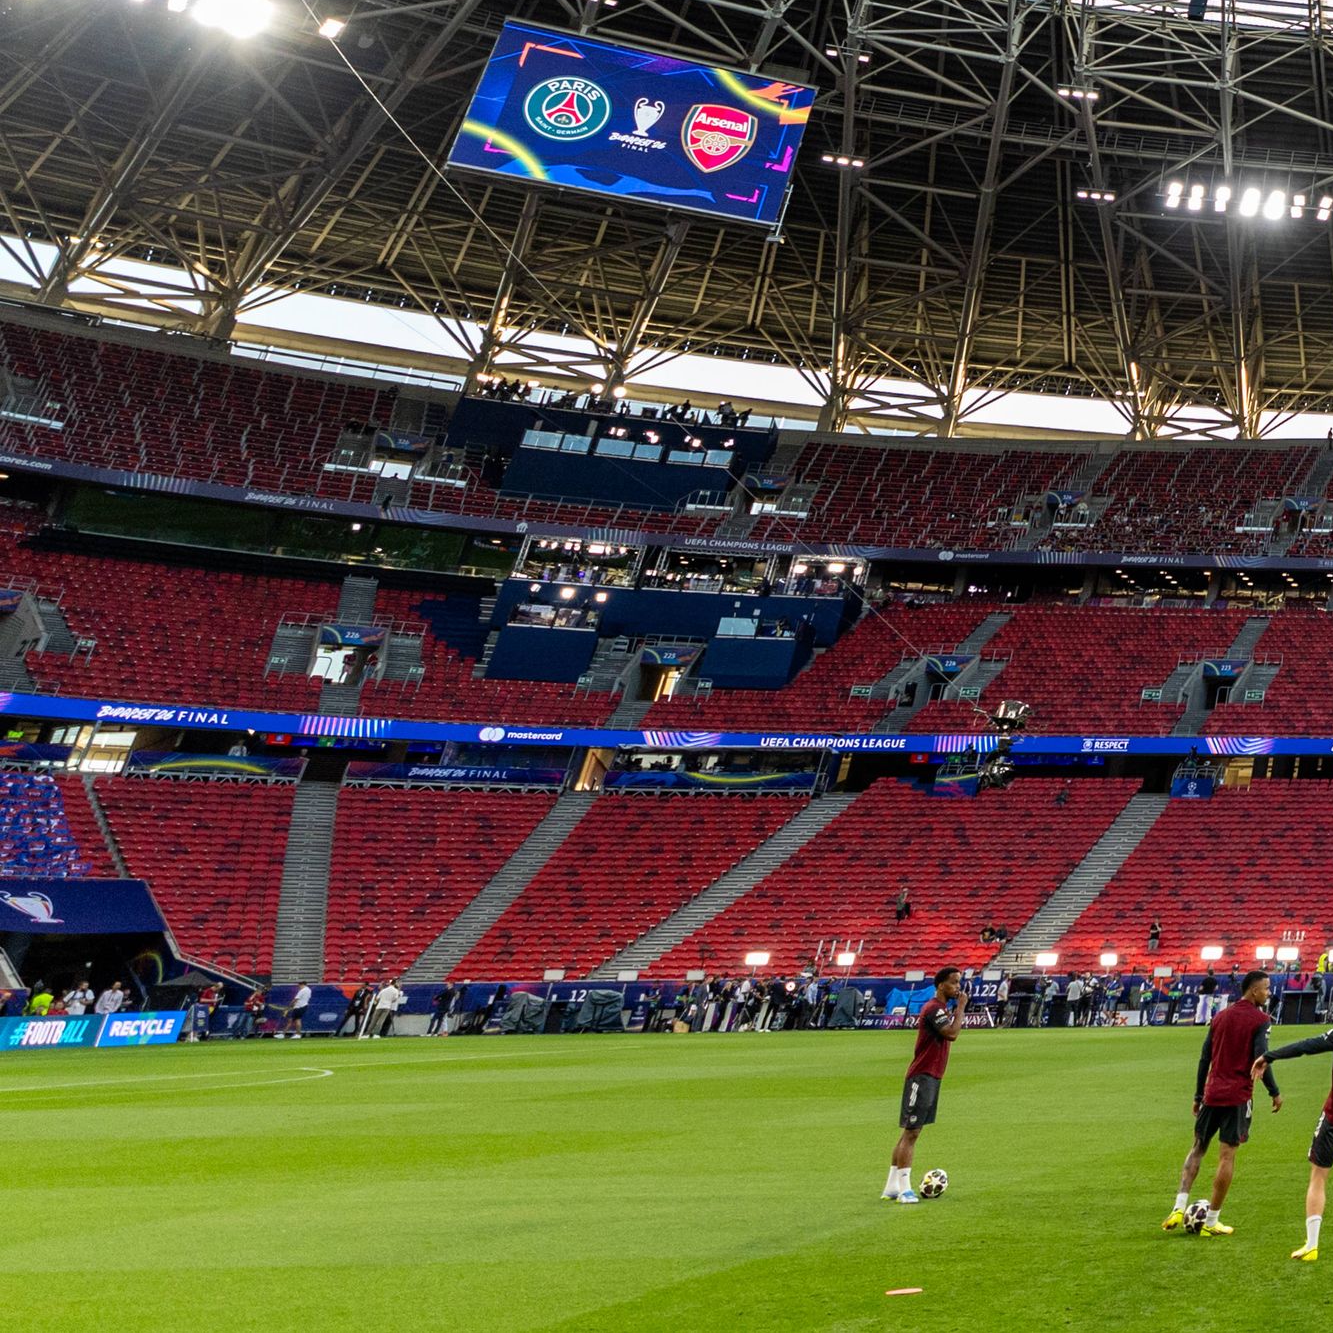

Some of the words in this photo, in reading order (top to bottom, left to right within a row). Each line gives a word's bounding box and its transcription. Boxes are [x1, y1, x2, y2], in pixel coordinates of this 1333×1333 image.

[547, 79, 601, 102] PARIS
[695, 113, 748, 133] Arsenal
[608, 132, 654, 148] BUDAPEST
[621, 143, 648, 153] FINAL
[299, 499, 335, 511] FINAL
[685, 538, 707, 548] UEFA
[709, 540, 759, 551] CHAMPIONS
[761, 543, 793, 553] LEAGUE
[1159, 556, 1184, 565] FINAL
[97, 705, 156, 721] BUDAPEST
[177, 710, 229, 725] FINAL
[507, 731, 563, 741] mastercard
[760, 737, 790, 748] UEFA
[792, 738, 860, 749] CHAMPIONS
[863, 739, 906, 750] LEAGUE
[1094, 740, 1129, 750] RESPECT
[408, 767, 454, 779] BUDAPEST
[468, 769, 508, 780] FINAL
[568, 989, 590, 1003] 12
[972, 984, 998, 998] 122
[9, 1020, 90, 1046] #FOOTBALL
[109, 1019, 176, 1038] RECYCLE
